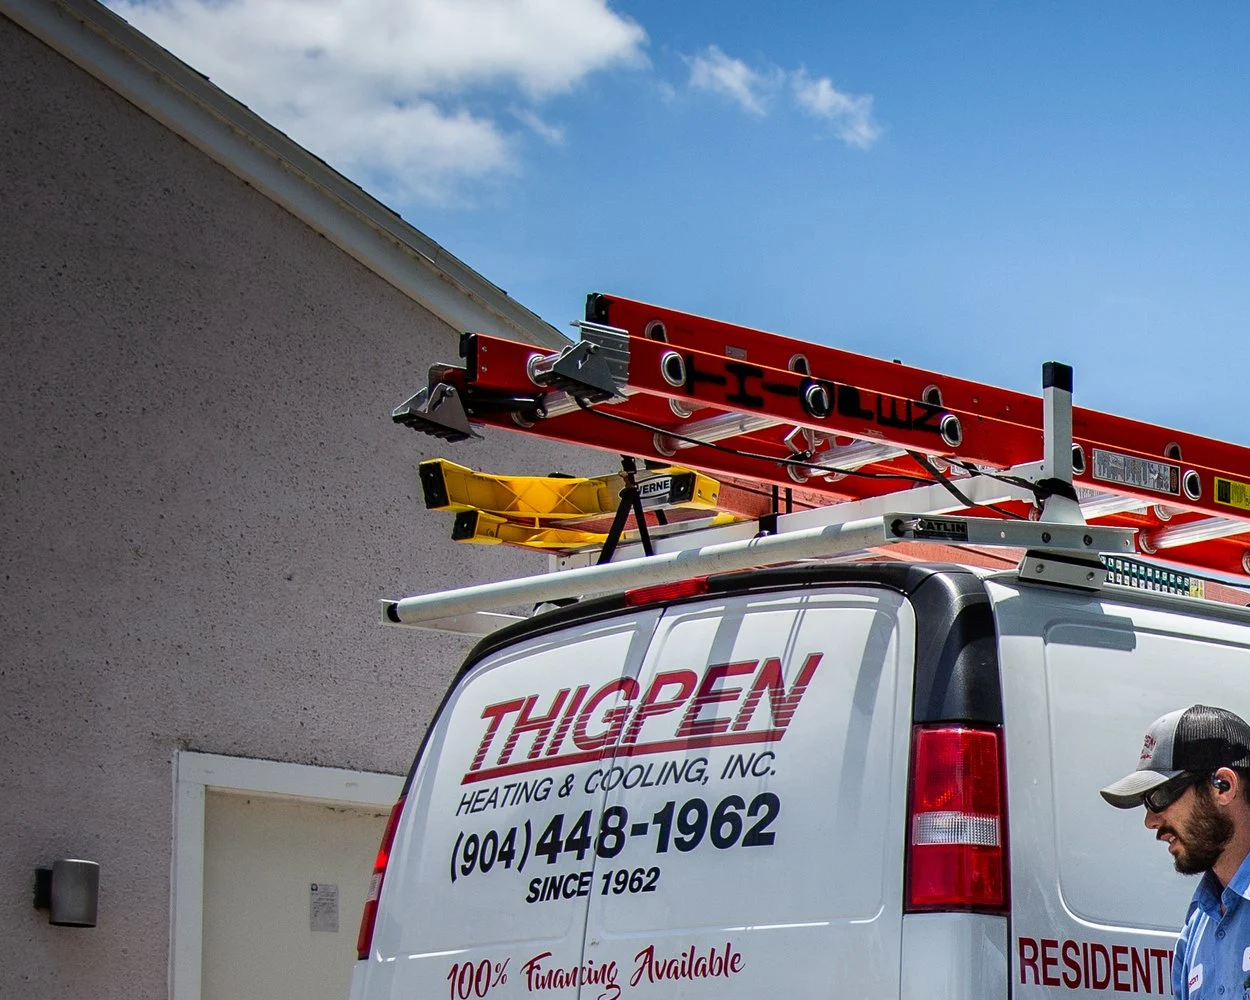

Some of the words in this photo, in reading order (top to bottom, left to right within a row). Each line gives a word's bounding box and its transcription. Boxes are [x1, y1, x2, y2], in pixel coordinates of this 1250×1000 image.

[921, 521, 966, 533] ATLIN
[469, 652, 824, 772] THIGPEN
[455, 777, 554, 817] HEATING
[557, 776, 575, 799] &
[585, 756, 709, 792] COOLING,
[720, 751, 776, 780] INC.
[526, 871, 593, 903] SINCE
[600, 866, 661, 896] 1962
[447, 957, 510, 1000] 100%
[630, 943, 745, 989] Available
